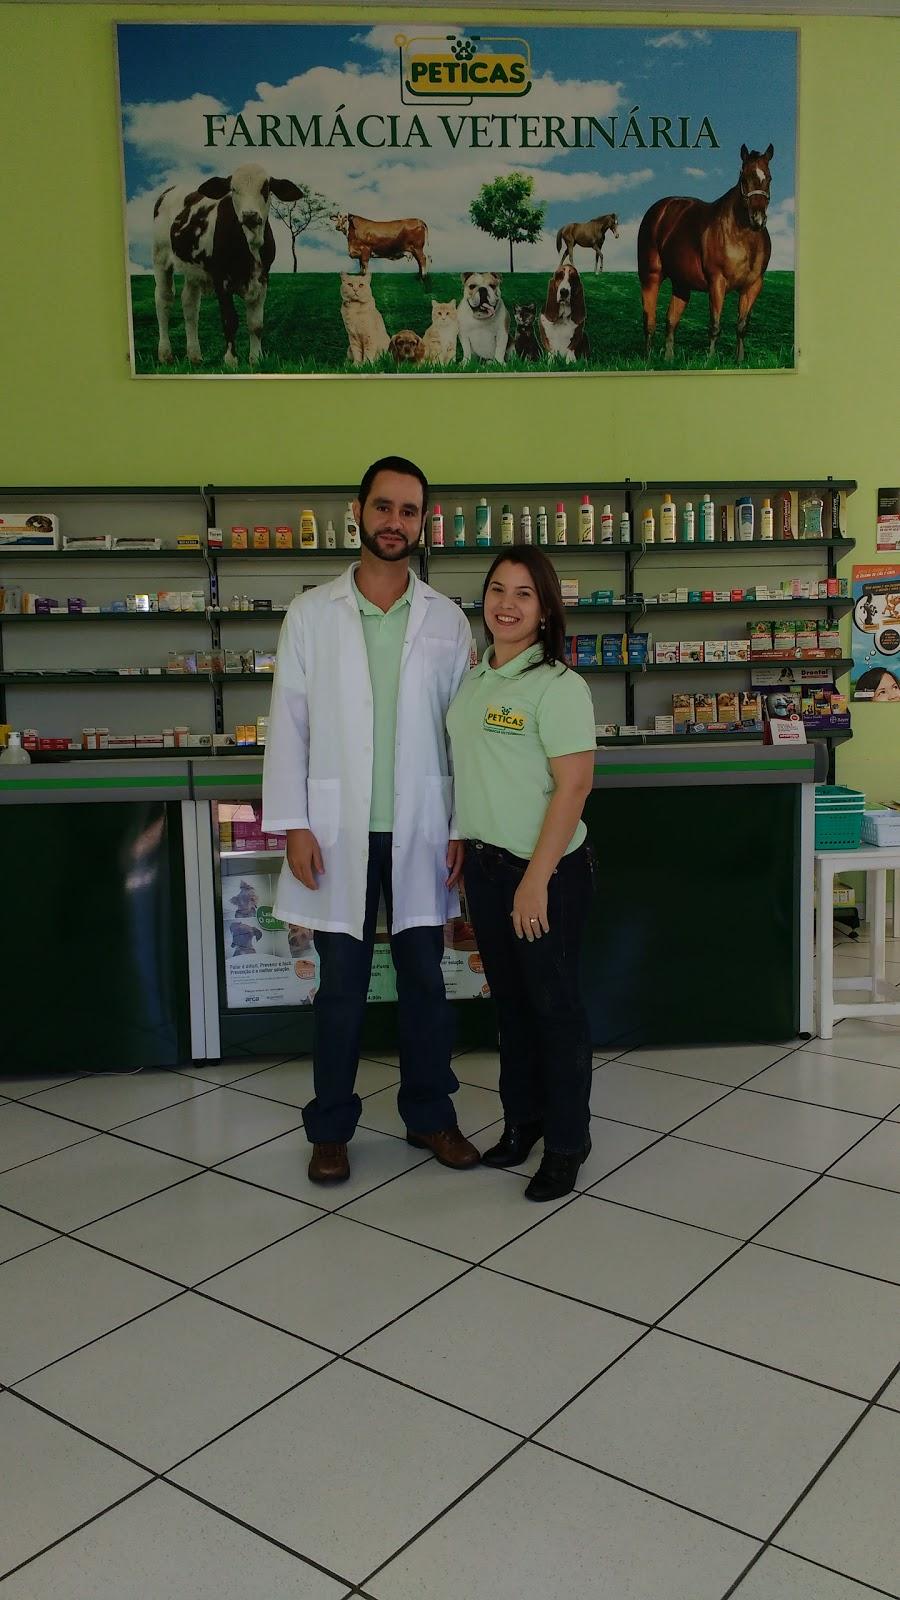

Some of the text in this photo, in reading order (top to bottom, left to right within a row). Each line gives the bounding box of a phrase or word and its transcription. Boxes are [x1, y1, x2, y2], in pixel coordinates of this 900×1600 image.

[411, 62, 526, 84] PETICAS
[203, 104, 721, 149] FARMÁCIA VETERINÁRIA
[487, 713, 524, 726] PETICAS
